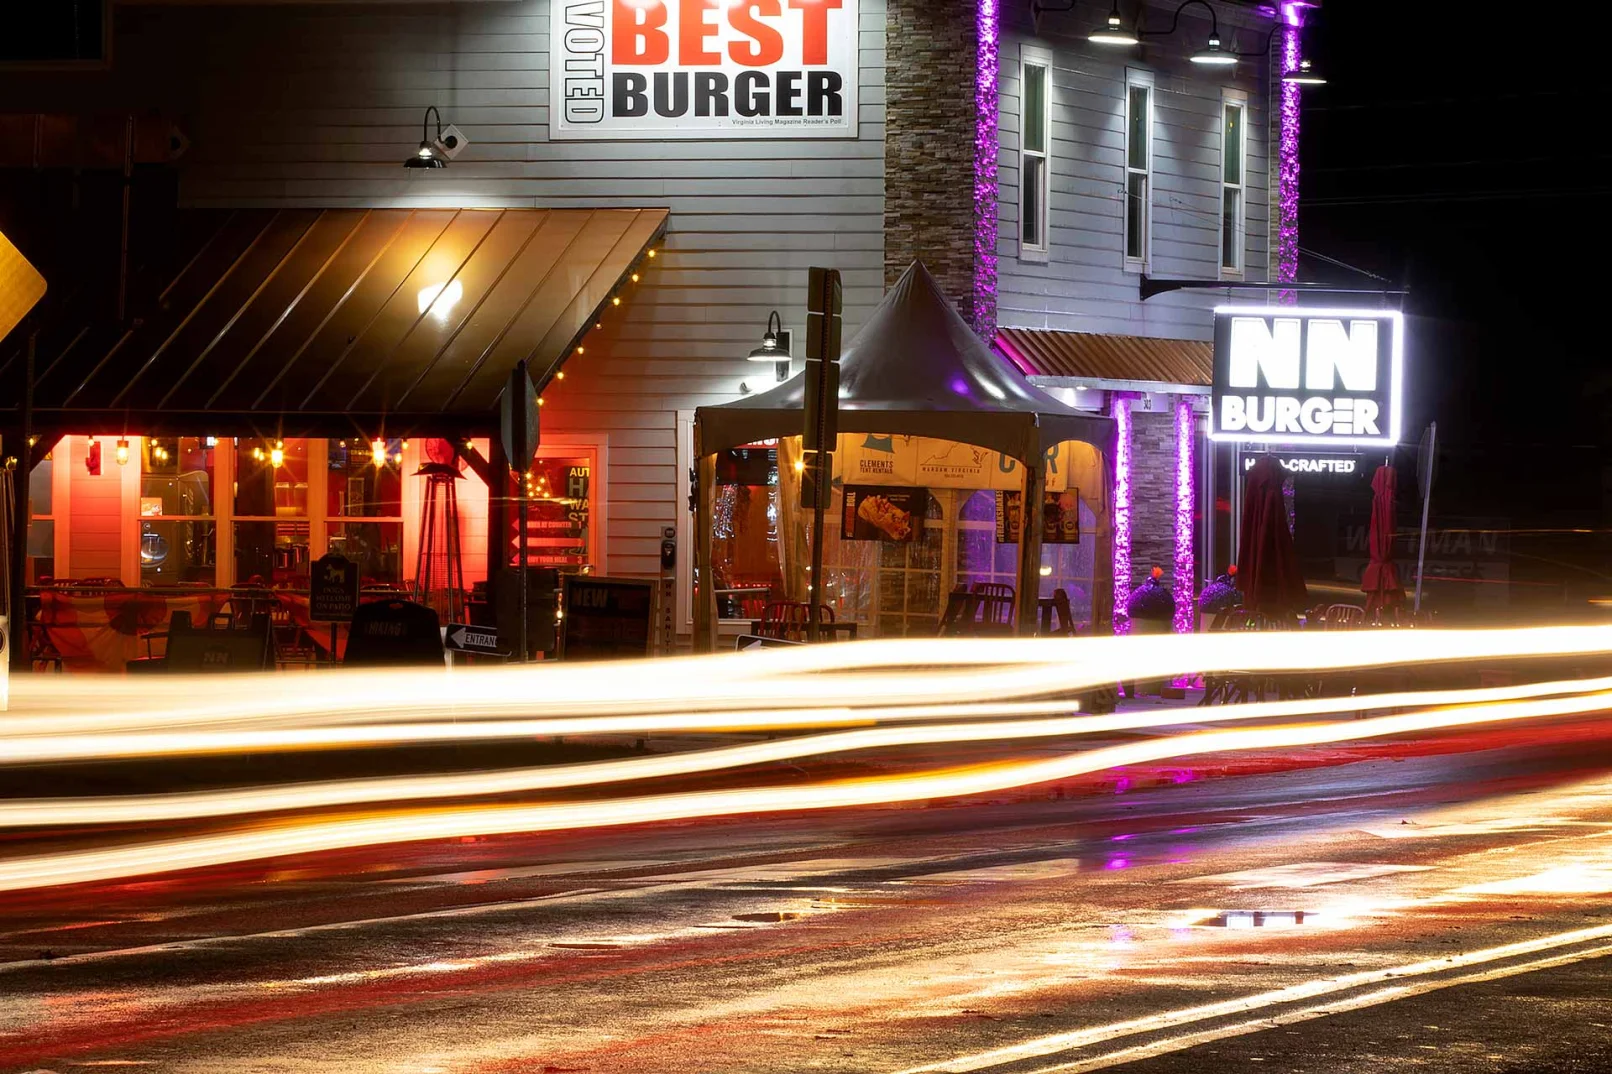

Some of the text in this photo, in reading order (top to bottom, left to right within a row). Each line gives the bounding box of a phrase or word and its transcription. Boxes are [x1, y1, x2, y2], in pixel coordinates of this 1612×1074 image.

[611, 0, 842, 66] BEST
[564, 0, 604, 124] VOTED
[612, 70, 843, 118] BURGER
[732, 118, 754, 126] Virginia
[755, 118, 773, 126] Living
[775, 118, 801, 126] Magazine
[1228, 316, 1378, 392] NN
[1221, 395, 1381, 436] BURGER
[860, 460, 894, 468] CLEMENTS
[1245, 458, 1356, 472] H-CRAFTED
[465, 633, 498, 646] ENTRAN
